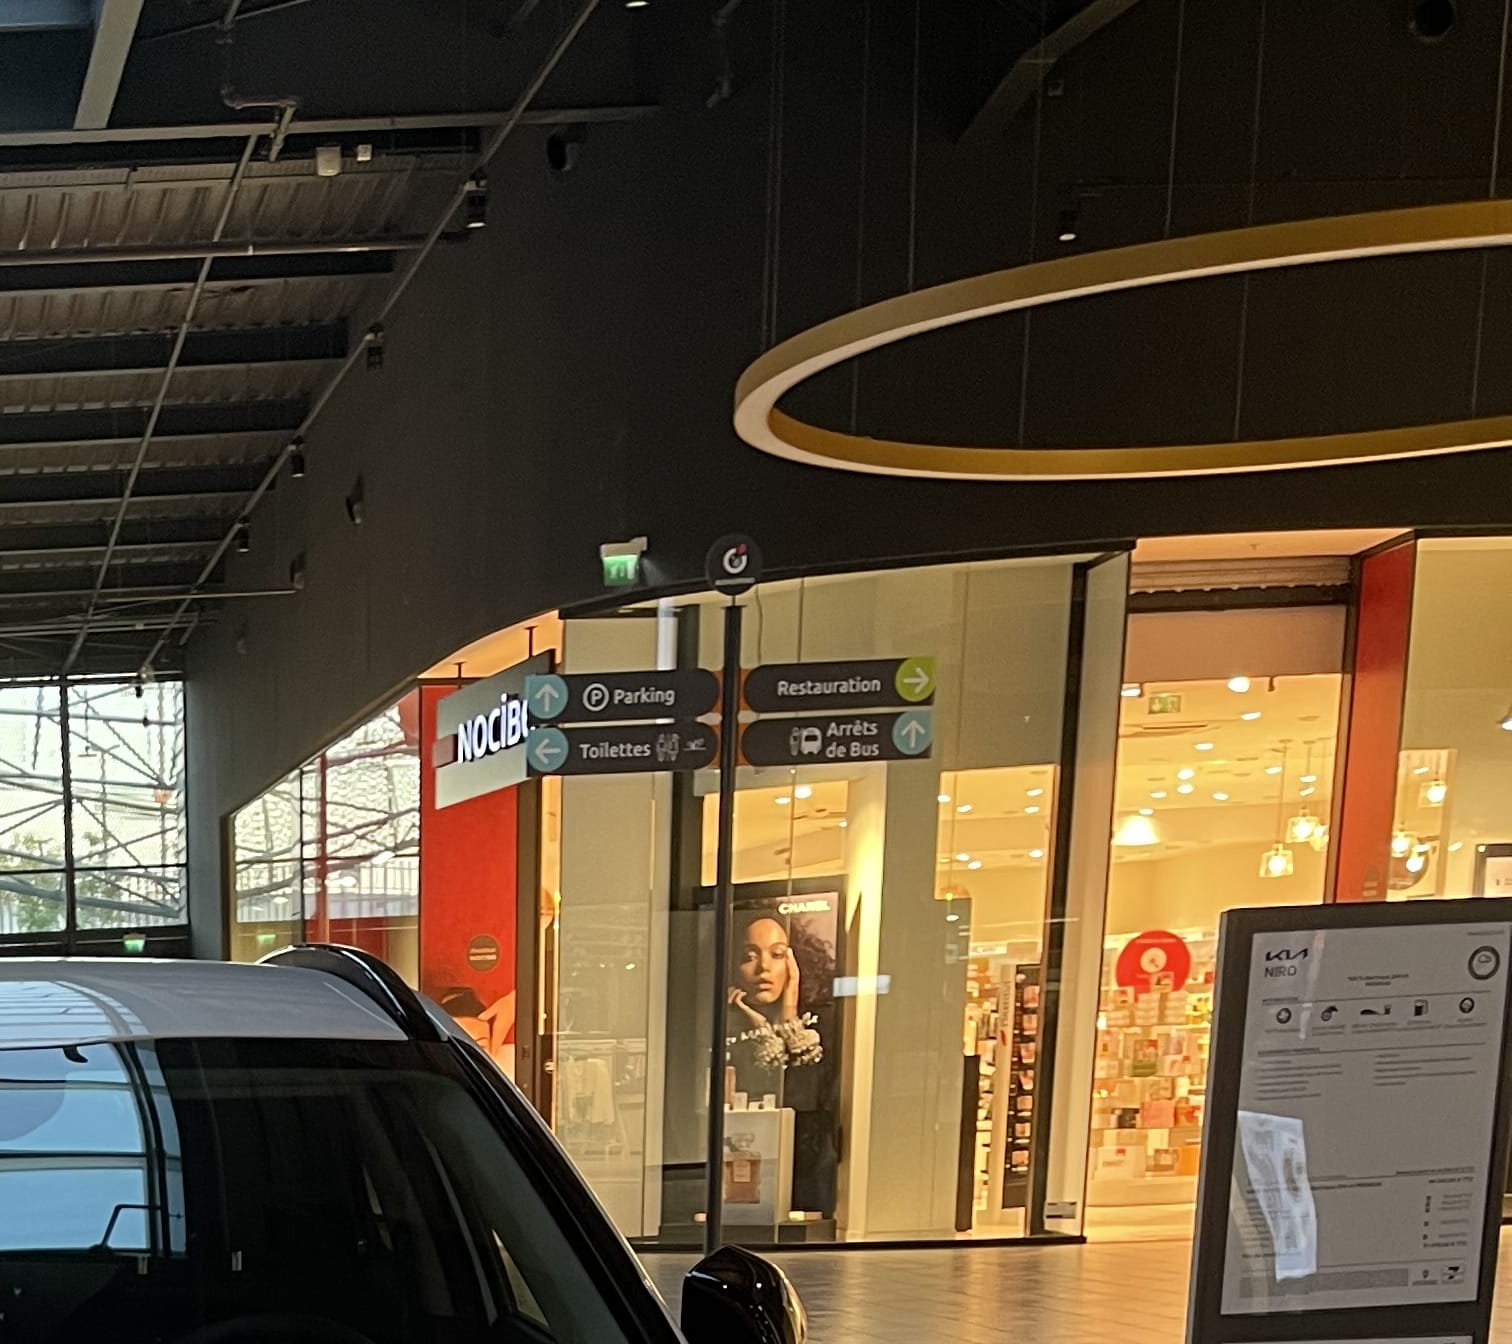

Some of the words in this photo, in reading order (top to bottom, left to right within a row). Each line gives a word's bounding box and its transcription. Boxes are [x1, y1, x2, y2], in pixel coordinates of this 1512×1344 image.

[777, 677, 881, 696] Restauration
[613, 688, 675, 706] Parking
[826, 720, 878, 737] Arrêts
[579, 742, 651, 760] Toilettes
[825, 742, 847, 758] de
[850, 741, 879, 757] Bus
[778, 900, 831, 915] CHANEL
[1265, 948, 1309, 962] KIA
[1264, 965, 1297, 979] NIRO
